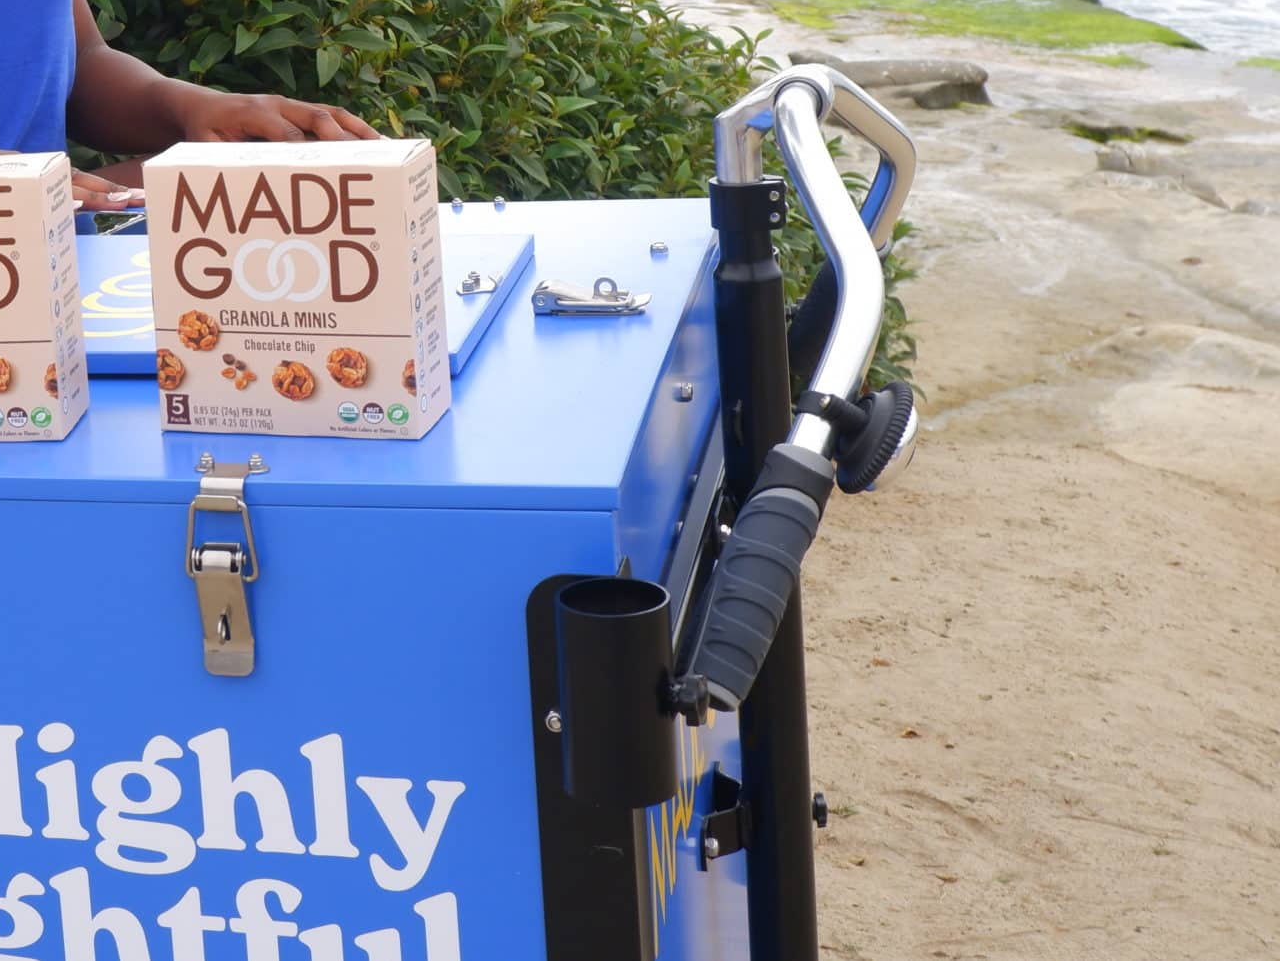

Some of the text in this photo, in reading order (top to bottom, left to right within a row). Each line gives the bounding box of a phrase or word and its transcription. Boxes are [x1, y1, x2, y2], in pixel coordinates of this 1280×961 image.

[172, 171, 376, 236] MADE
[174, 237, 379, 303] GOOD
[219, 309, 337, 329] GRANOLA MINIS
[244, 339, 315, 354] Chocolate Chip
[171, 396, 184, 415] 5
[210, 407, 219, 415] OZ
[242, 407, 253, 416] PER
[256, 408, 272, 417] PACK
[240, 419, 248, 427] OZ
